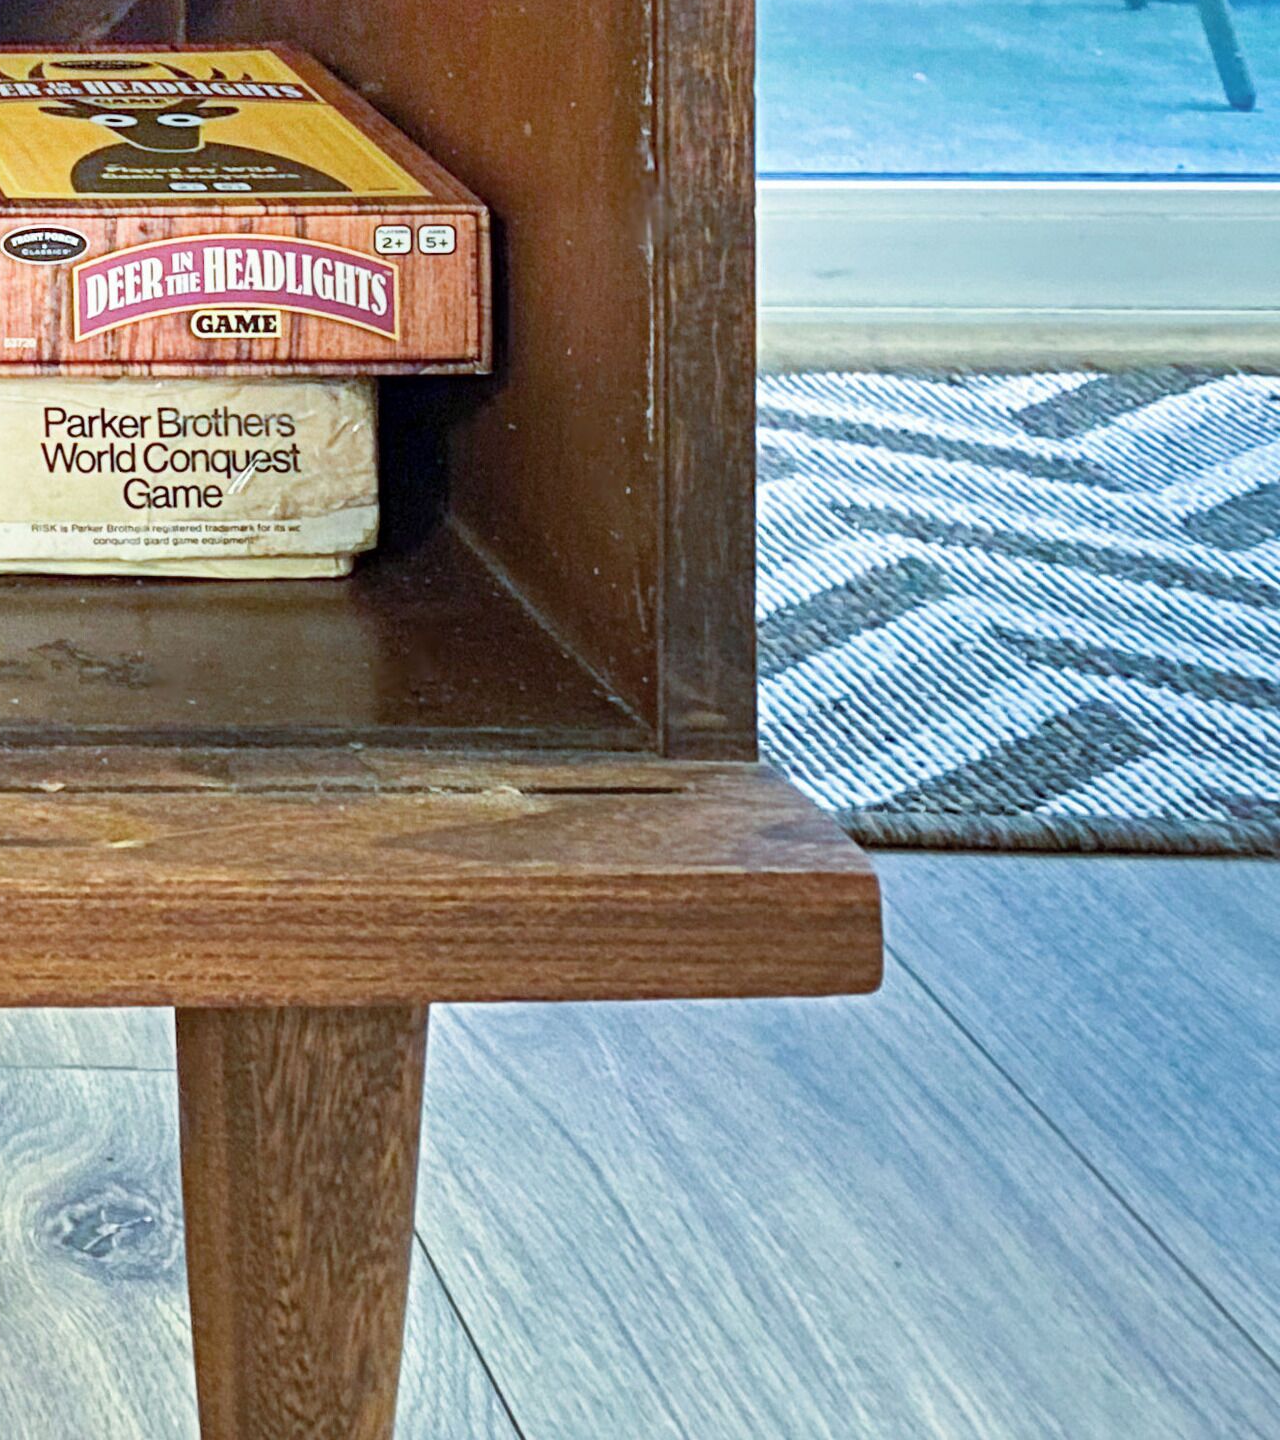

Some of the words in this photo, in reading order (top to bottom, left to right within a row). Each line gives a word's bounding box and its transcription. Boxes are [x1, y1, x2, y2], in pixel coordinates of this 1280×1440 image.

[82, 82, 306, 100] HEADLIGHTS
[382, 237, 404, 249] 2+
[425, 236, 448, 249] 5+
[171, 251, 194, 273] IN
[85, 257, 165, 319] DEER
[165, 272, 201, 297] THE
[202, 246, 388, 317] HEADLIGHTS
[195, 314, 277, 334] GAME
[43, 407, 152, 439] Parker
[157, 406, 296, 438] Brothers
[41, 443, 137, 474] World
[142, 441, 302, 479] Conquest
[122, 477, 224, 510] Game
